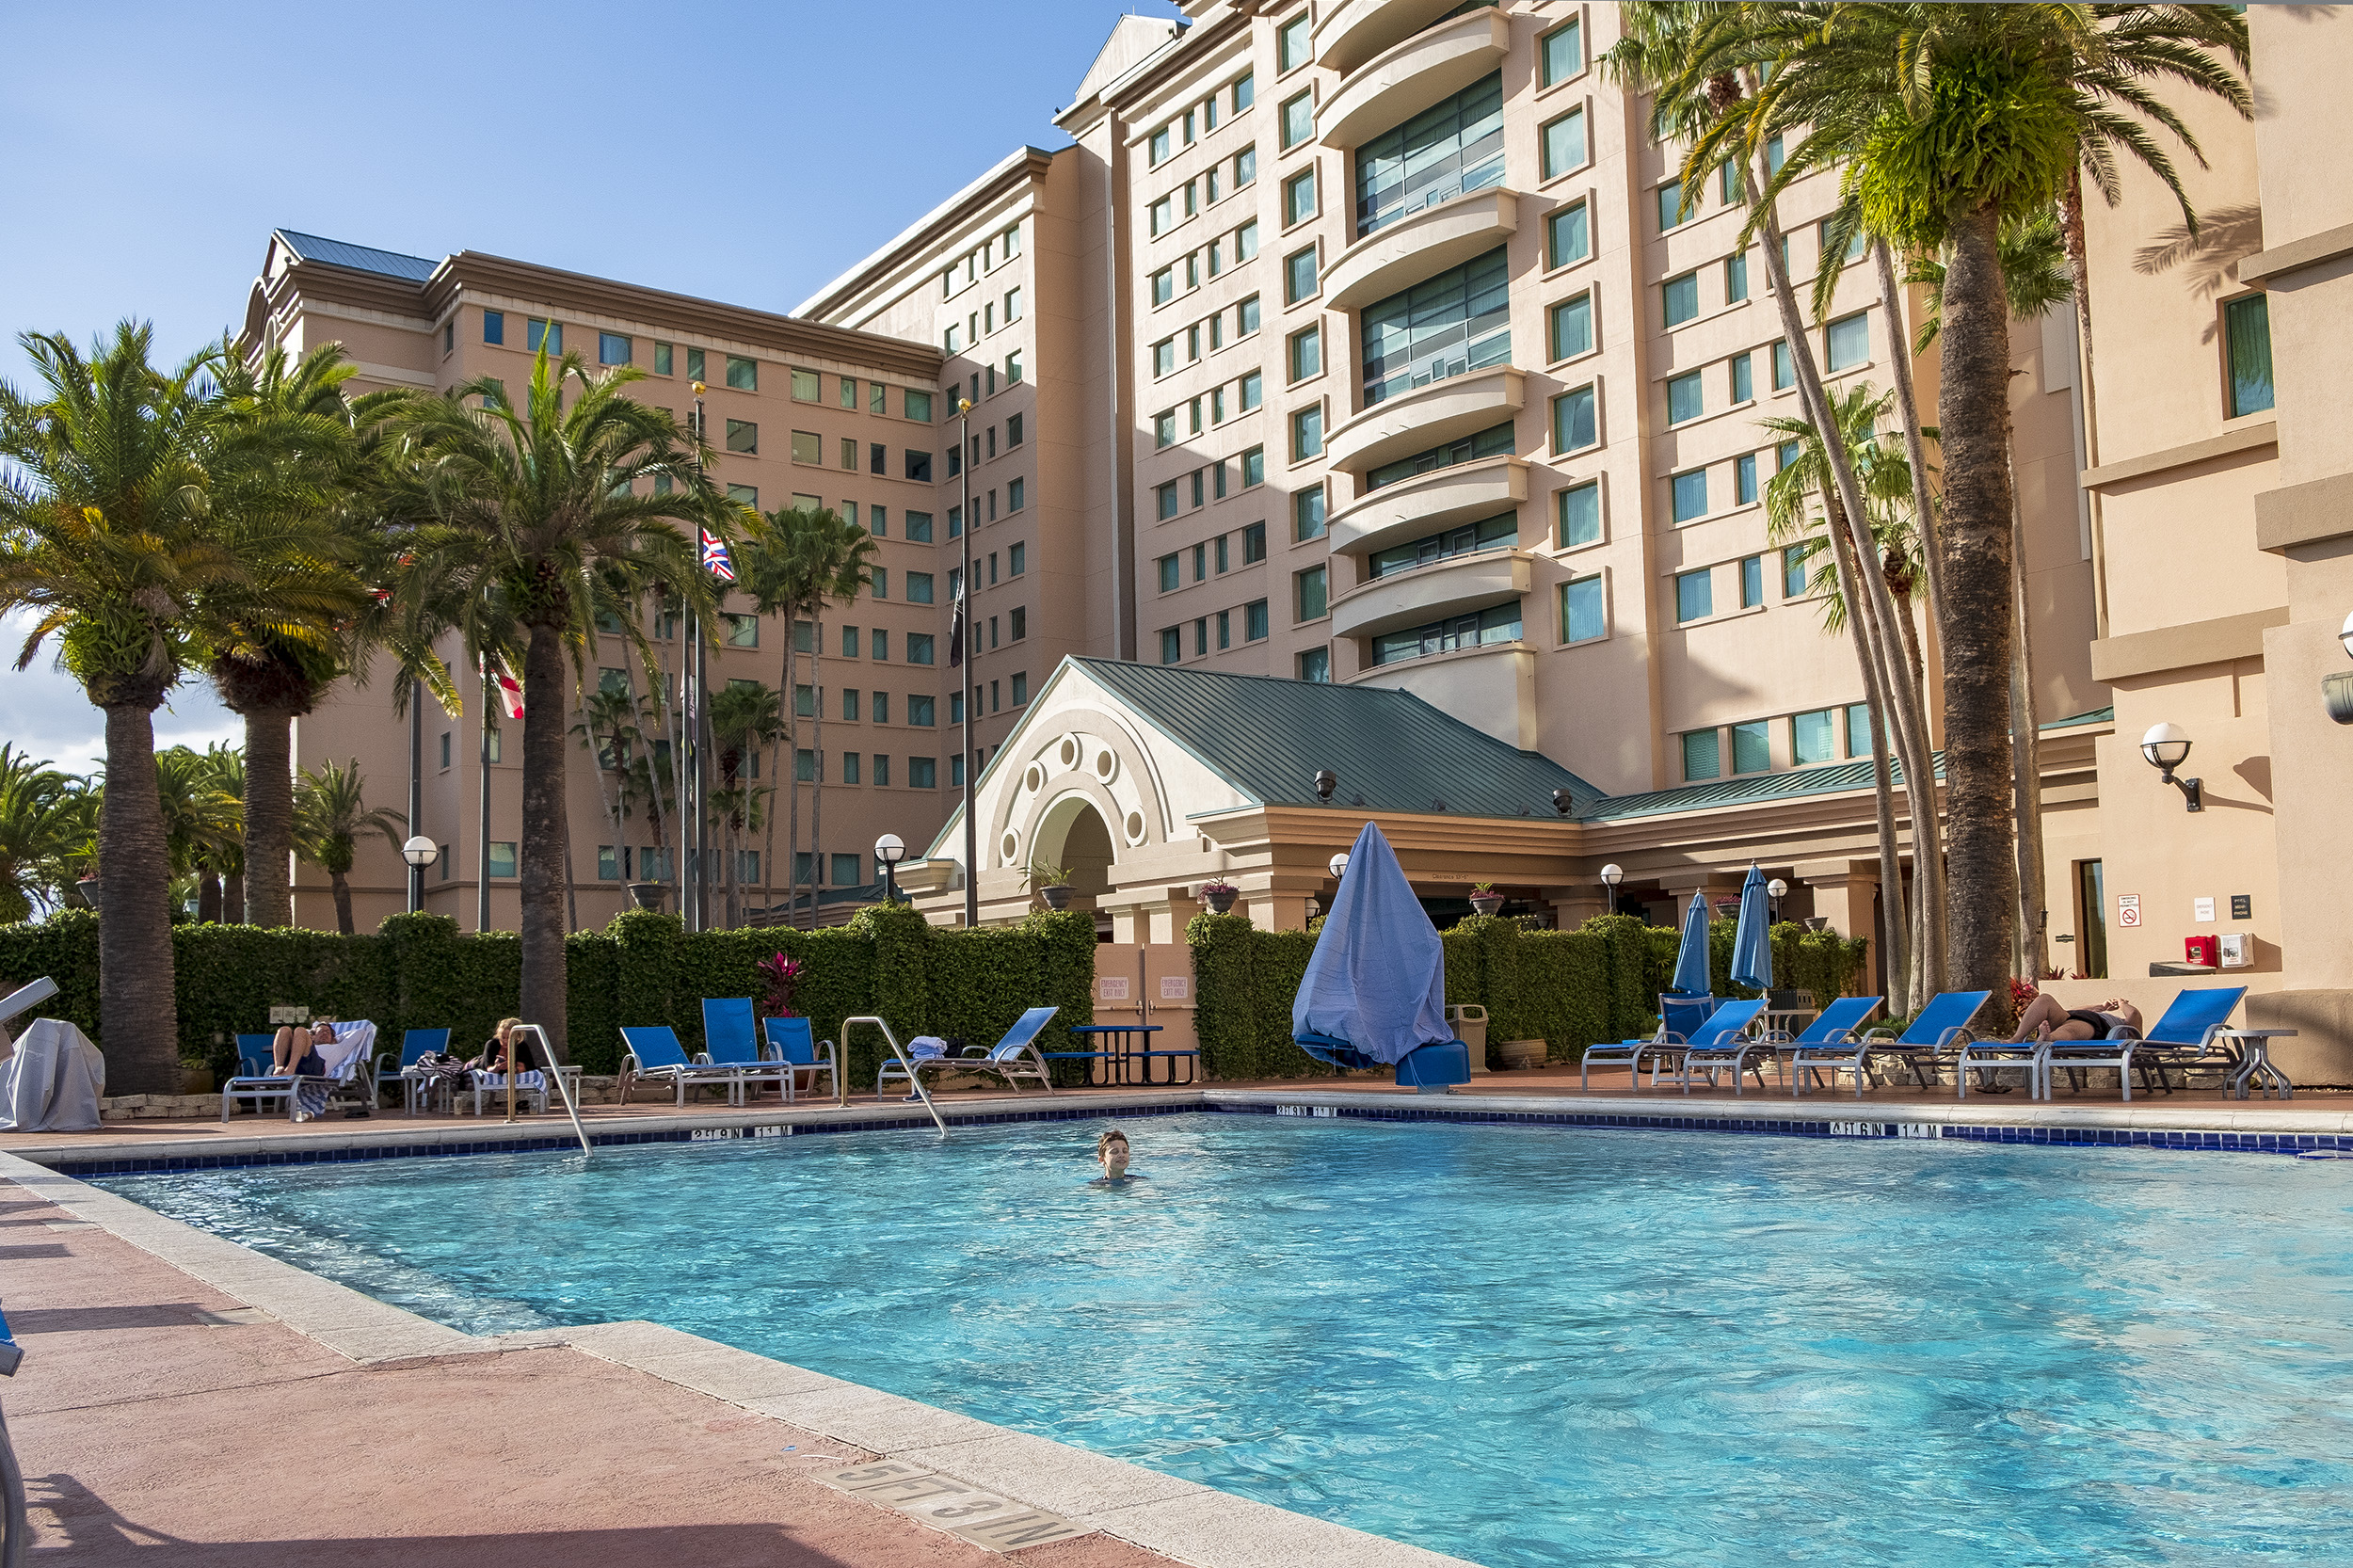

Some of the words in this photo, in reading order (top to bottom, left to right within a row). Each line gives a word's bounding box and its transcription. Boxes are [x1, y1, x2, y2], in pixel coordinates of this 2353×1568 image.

[1161, 979, 1186, 987] EMERGENCY
[780, 1126, 789, 1136] M
[1845, 1122, 1855, 1135] FT
[1860, 1123, 1867, 1136] 6
[1871, 1123, 1881, 1136] IN
[1928, 1125, 1937, 1138] M
[836, 1464, 910, 1481] 5
[871, 1478, 970, 1502] FT
[931, 1500, 1003, 1518] 3
[973, 1515, 1075, 1546] IN
